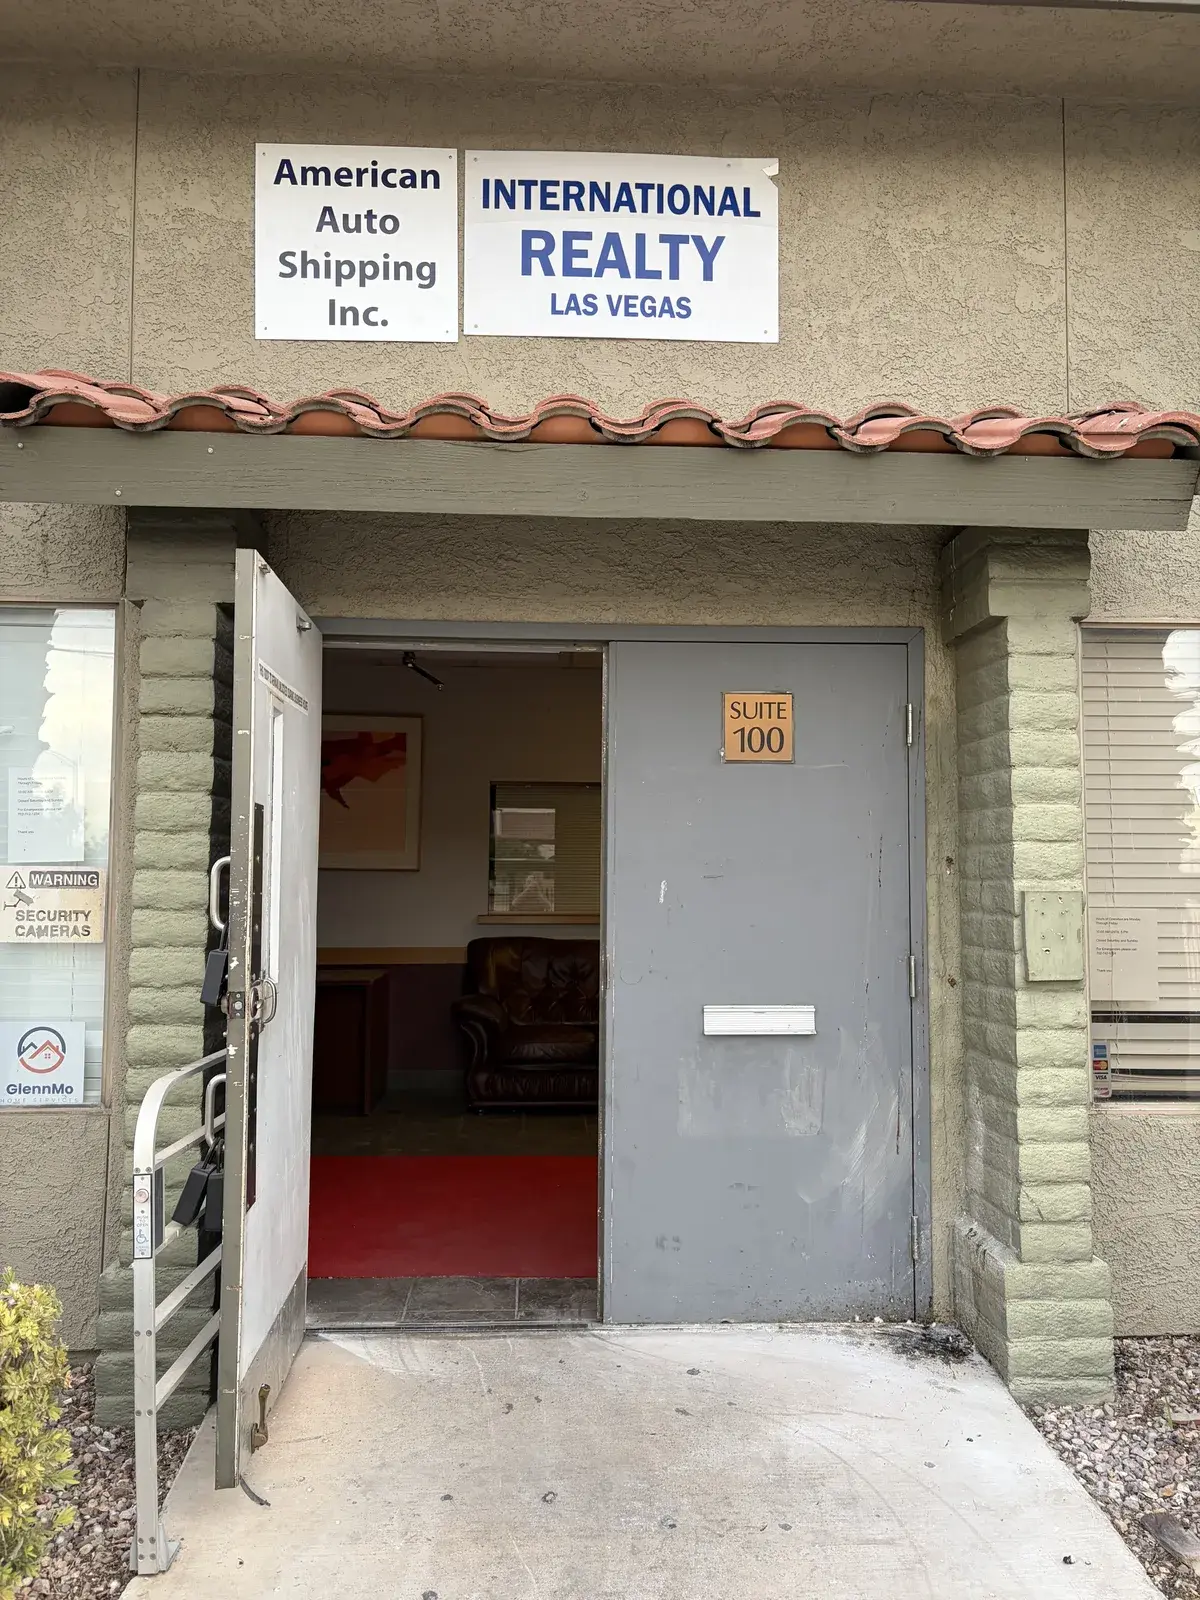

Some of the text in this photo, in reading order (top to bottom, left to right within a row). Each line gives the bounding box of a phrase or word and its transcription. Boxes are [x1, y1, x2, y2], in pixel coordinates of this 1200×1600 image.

[273, 158, 441, 191] American
[481, 178, 761, 219] INTERNATIONAL
[315, 206, 401, 236] Auto
[520, 229, 726, 283] REALTY
[278, 251, 437, 289] Shipping
[328, 299, 389, 327] Inc.
[549, 292, 693, 319] LAS VEGAS
[730, 701, 787, 719] SUITE
[733, 726, 784, 753] 100
[31, 873, 98, 886] WARNING
[15, 910, 91, 922] SECURITY
[15, 925, 91, 937] CAMERAS
[6, 1083, 74, 1094] GlennMo
